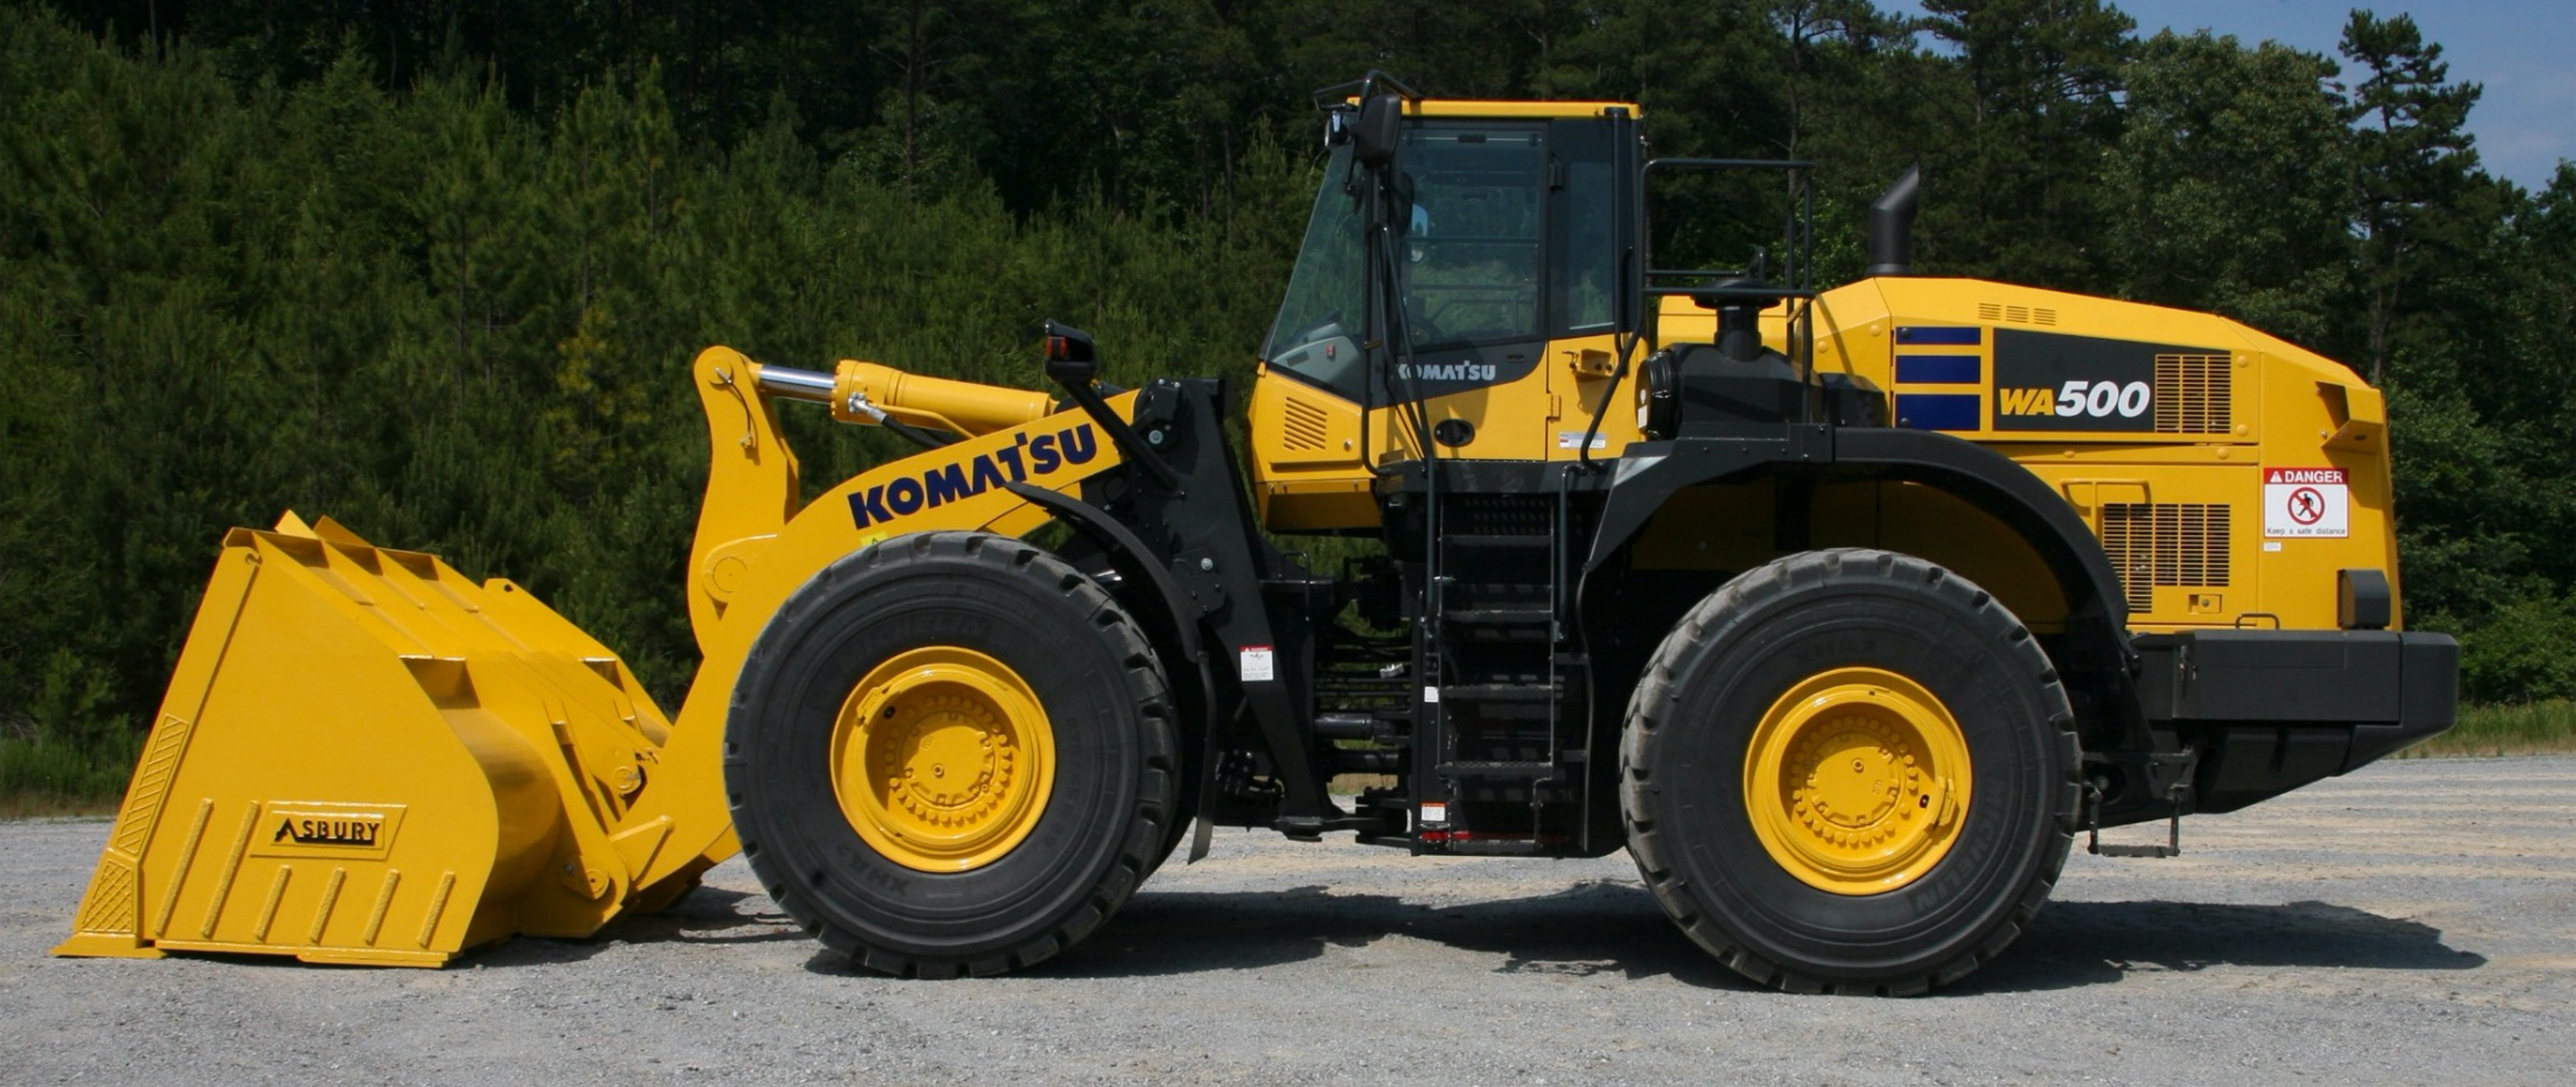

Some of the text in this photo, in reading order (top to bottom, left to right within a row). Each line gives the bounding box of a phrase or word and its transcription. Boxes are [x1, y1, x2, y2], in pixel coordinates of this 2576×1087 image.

[1999, 380, 2150, 418] WA500
[847, 423, 1097, 530] KOMATSU
[2285, 471, 2343, 483] DANGER
[2267, 527, 2286, 535] Keep
[274, 817, 380, 846] ASBURY
[1915, 775, 2006, 912] MICHELIN
